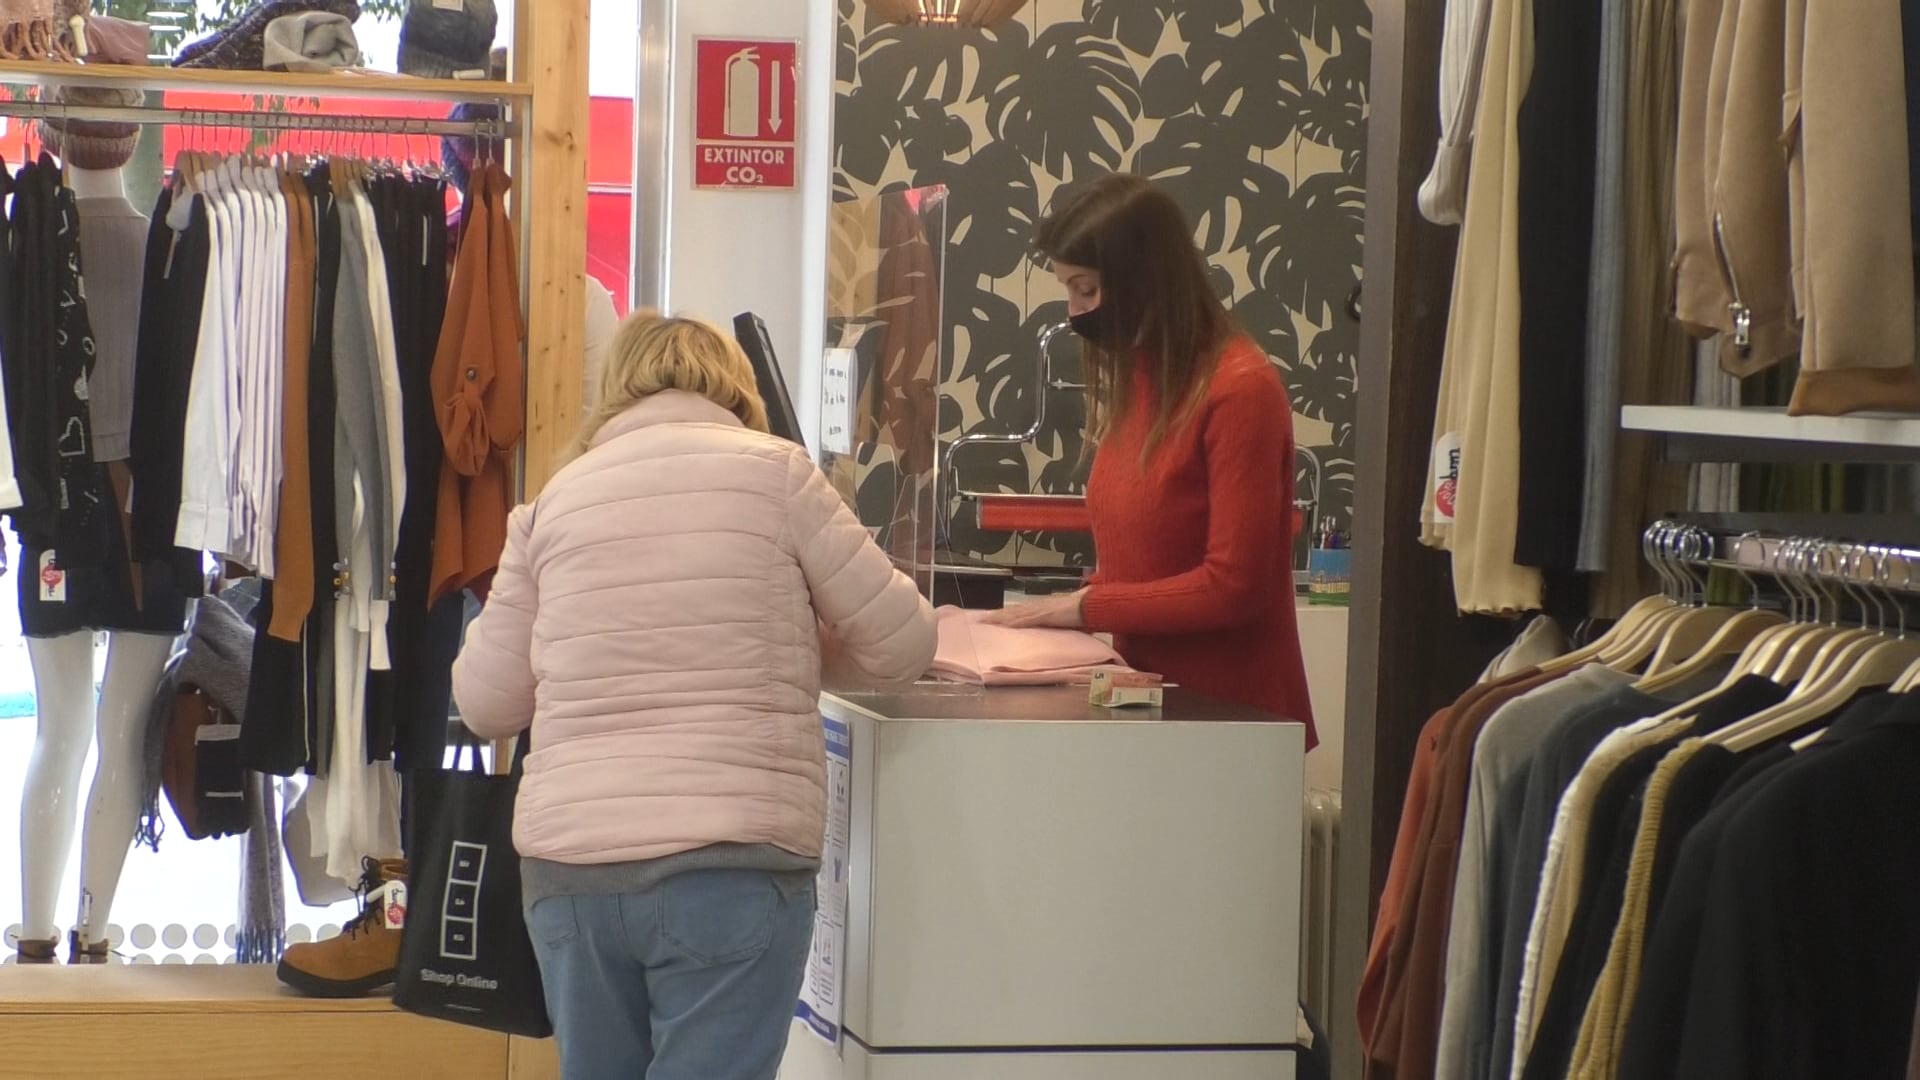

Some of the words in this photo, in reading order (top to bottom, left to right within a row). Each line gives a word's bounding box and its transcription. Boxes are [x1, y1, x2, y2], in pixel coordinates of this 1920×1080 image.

[704, 148, 785, 164] EXTINTOR
[420, 968, 455, 986] Shop
[456, 973, 498, 990] Online
